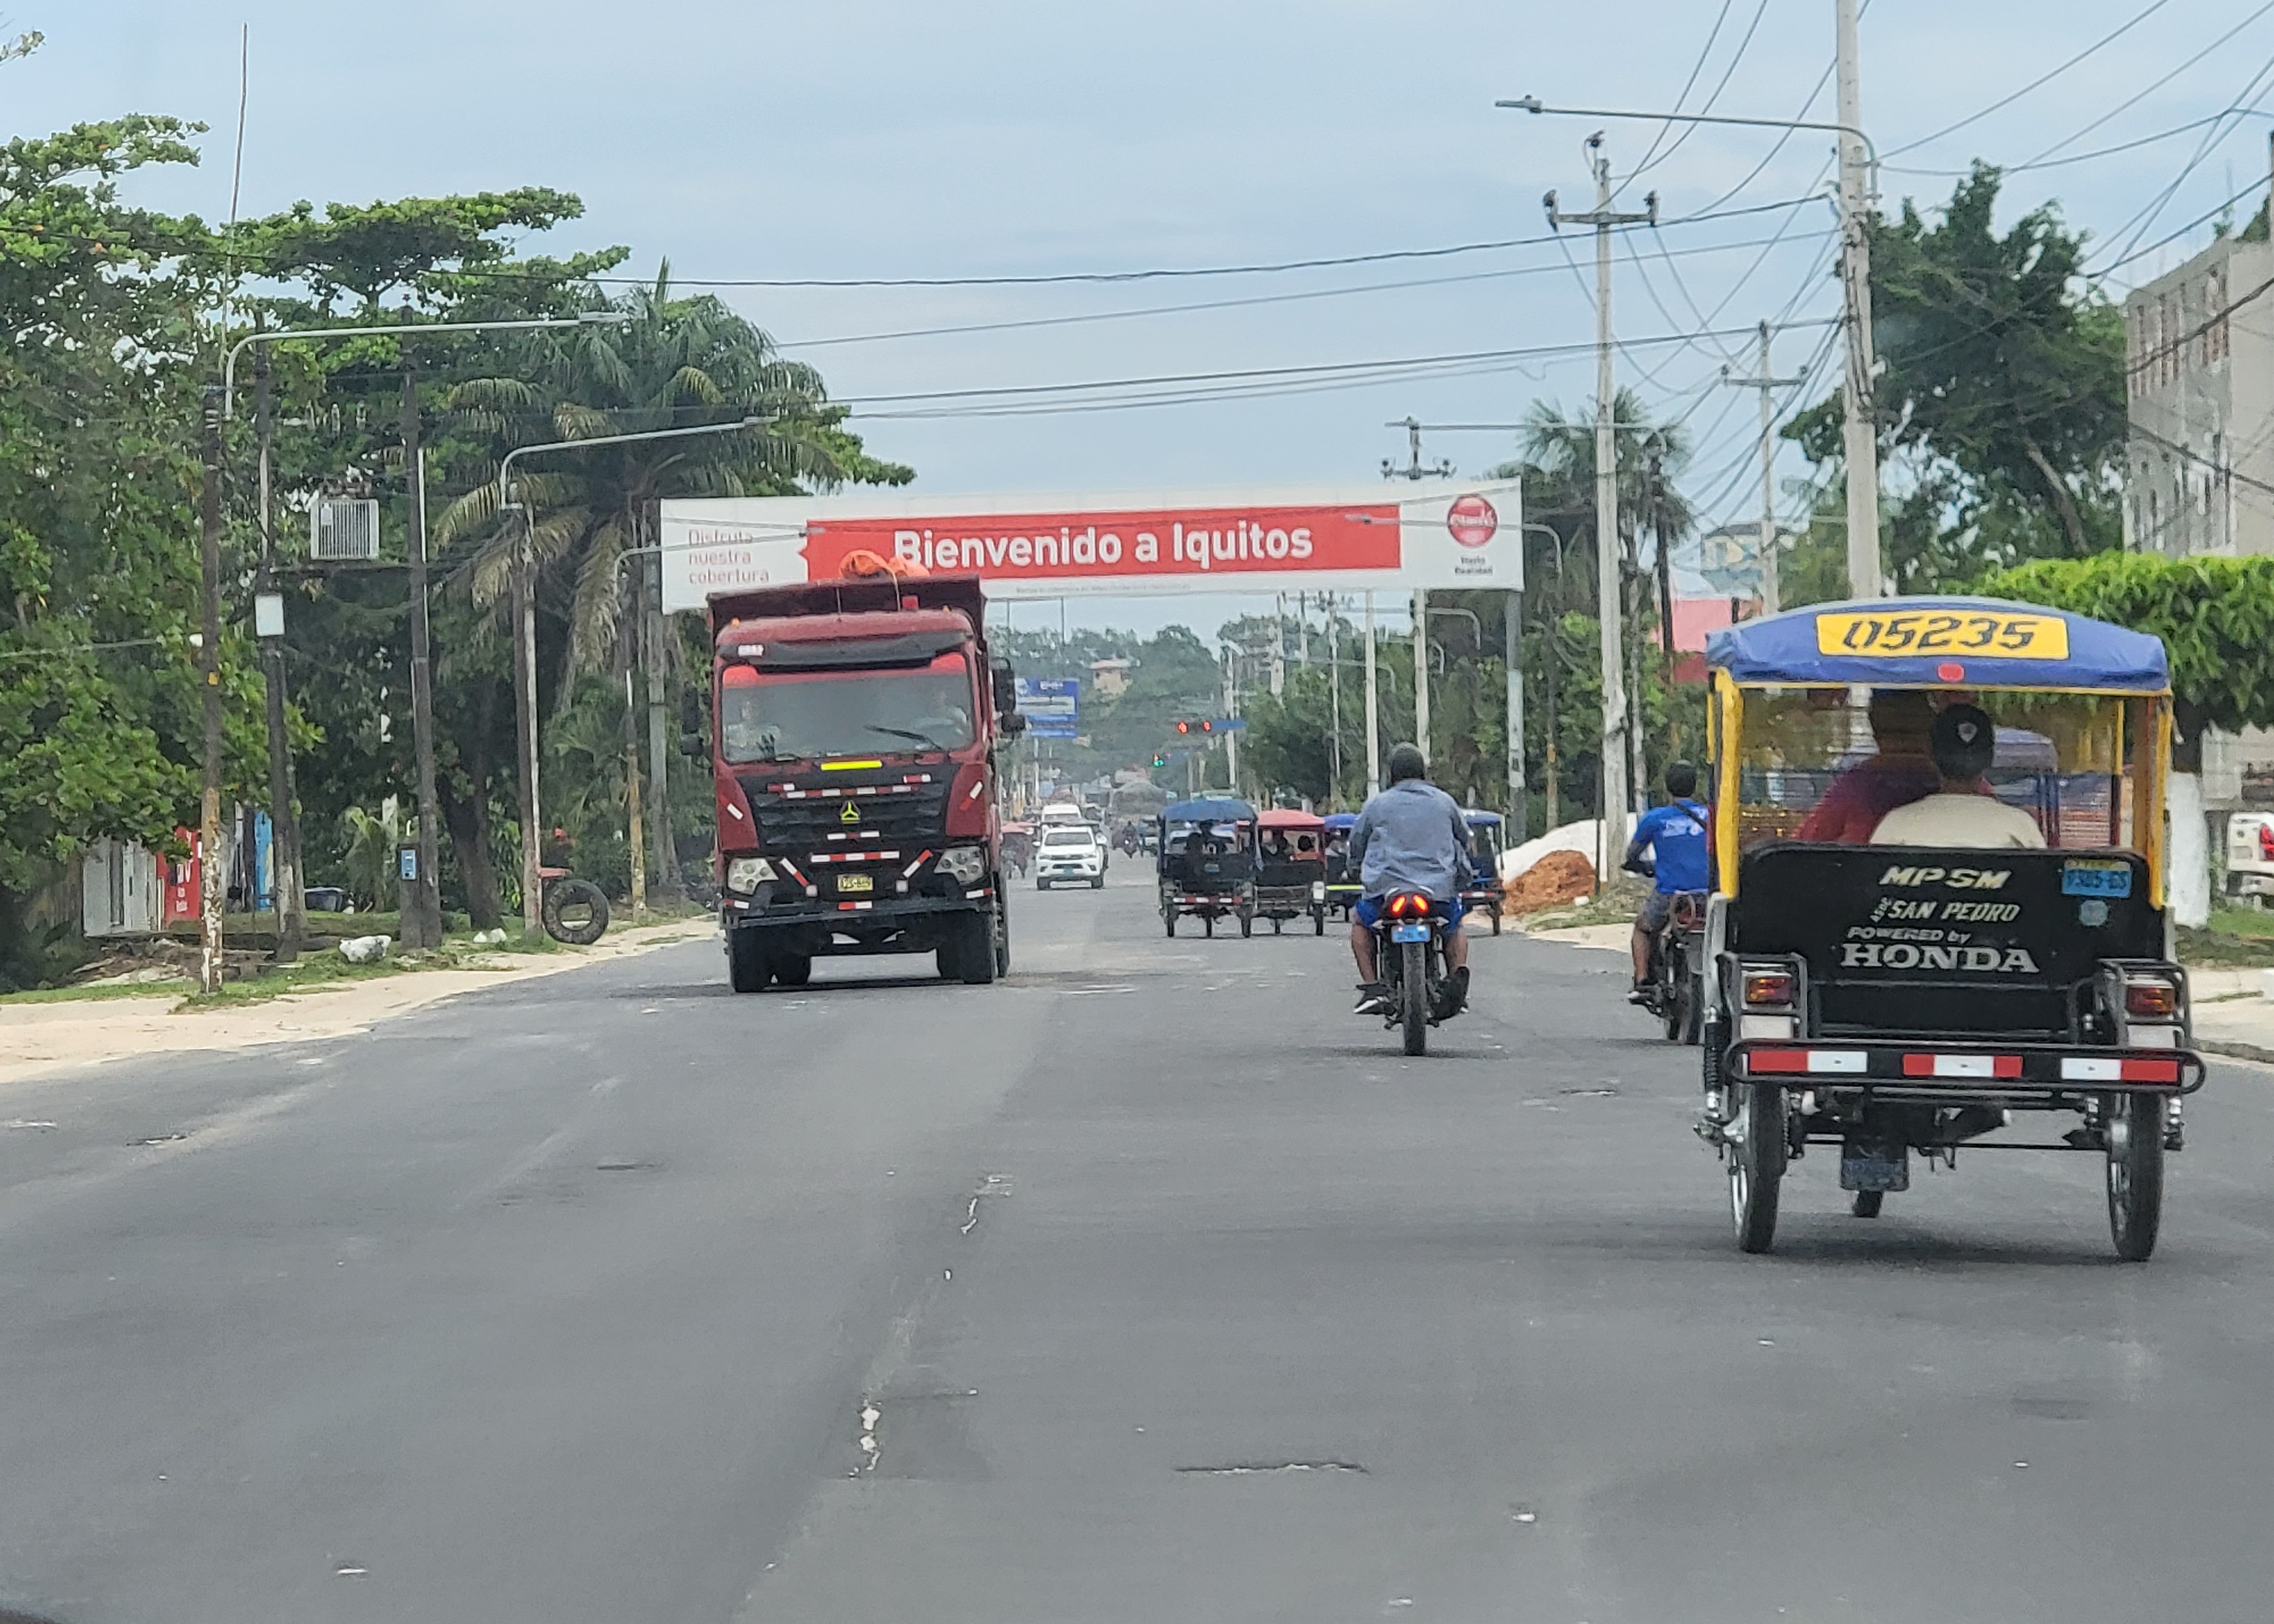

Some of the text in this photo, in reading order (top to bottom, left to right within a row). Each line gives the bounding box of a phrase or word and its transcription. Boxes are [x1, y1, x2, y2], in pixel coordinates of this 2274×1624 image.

[894, 520, 1313, 569] Bienvenido a Iquitos
[689, 549, 751, 565] nuestra
[689, 568, 769, 585] cobertura
[1842, 617, 2038, 649] 05235
[1888, 900, 1938, 920] SAN
[1940, 901, 2021, 922] PEDRO
[1847, 926, 1944, 941] POWERED
[1840, 943, 2040, 973] HONDA
